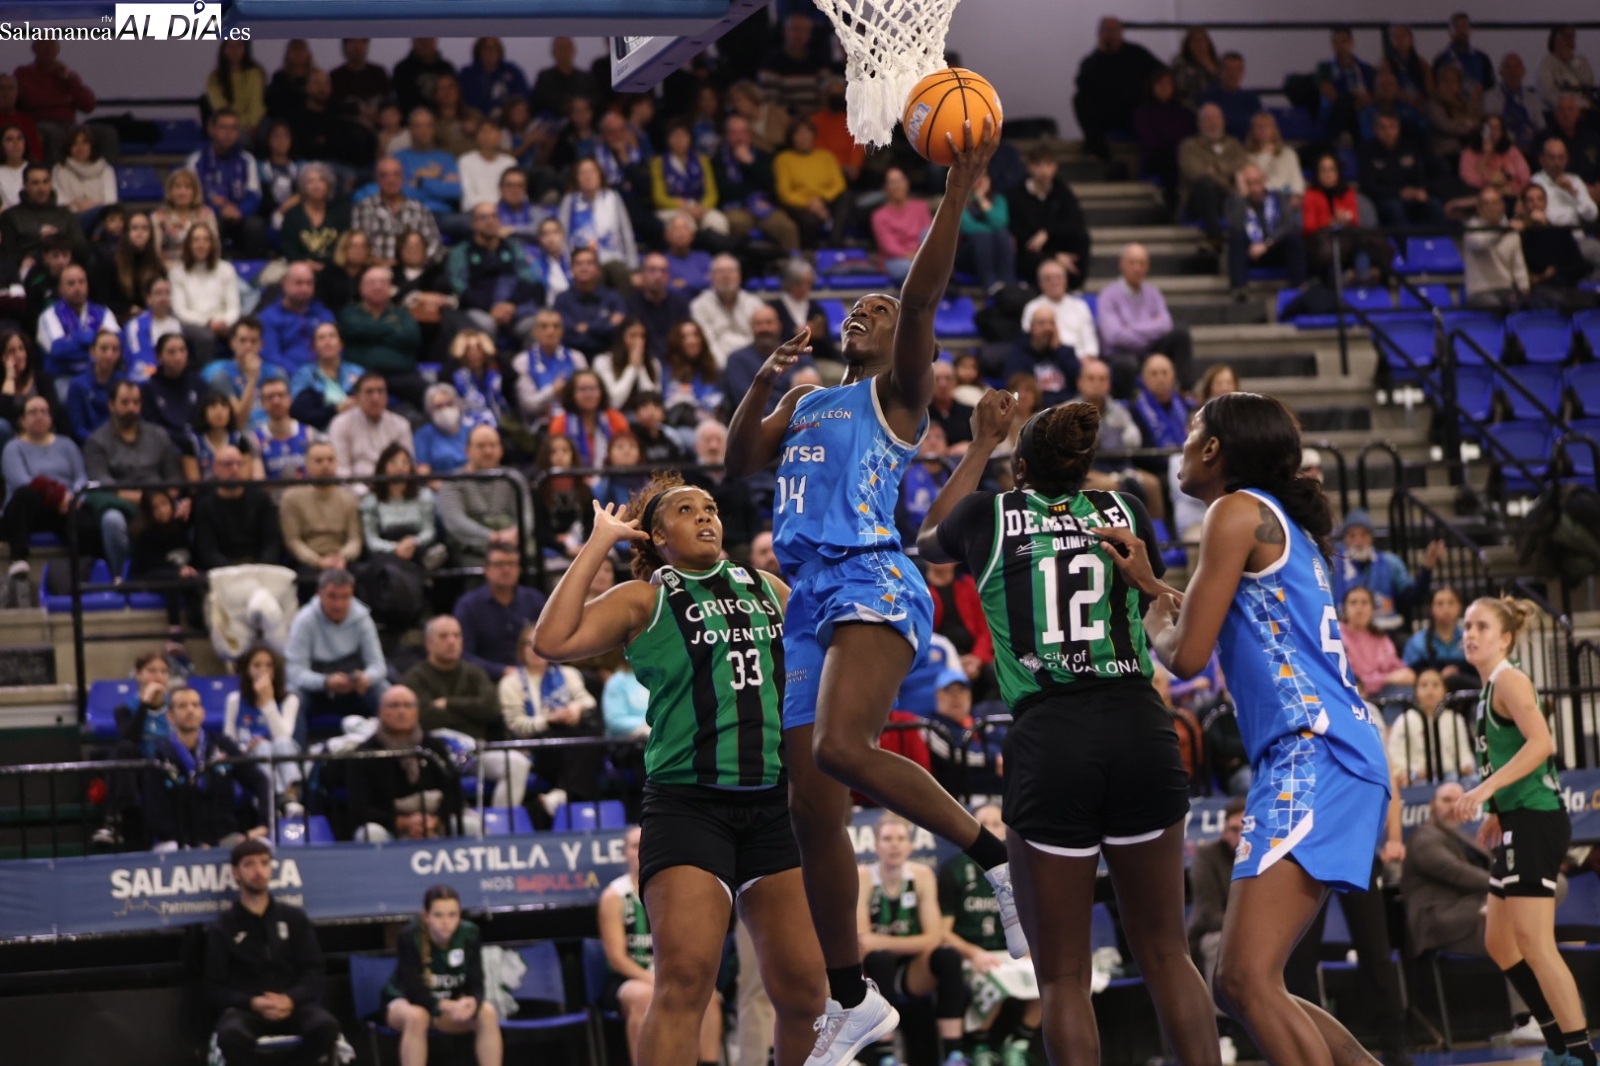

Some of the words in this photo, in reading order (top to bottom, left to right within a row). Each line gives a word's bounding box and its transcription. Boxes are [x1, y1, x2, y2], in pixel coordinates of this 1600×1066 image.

[821, 407, 852, 419] LEÓN
[776, 475, 807, 515] 14
[685, 598, 776, 623] GRIFOLS
[1038, 553, 1105, 644] 12
[726, 648, 764, 690] 33
[1044, 651, 1069, 663] city
[1073, 649, 1087, 663] of
[410, 843, 549, 875] CASTILLA
[561, 841, 582, 871] Y
[592, 839, 625, 864] LE
[110, 858, 303, 899] SALAMACA
